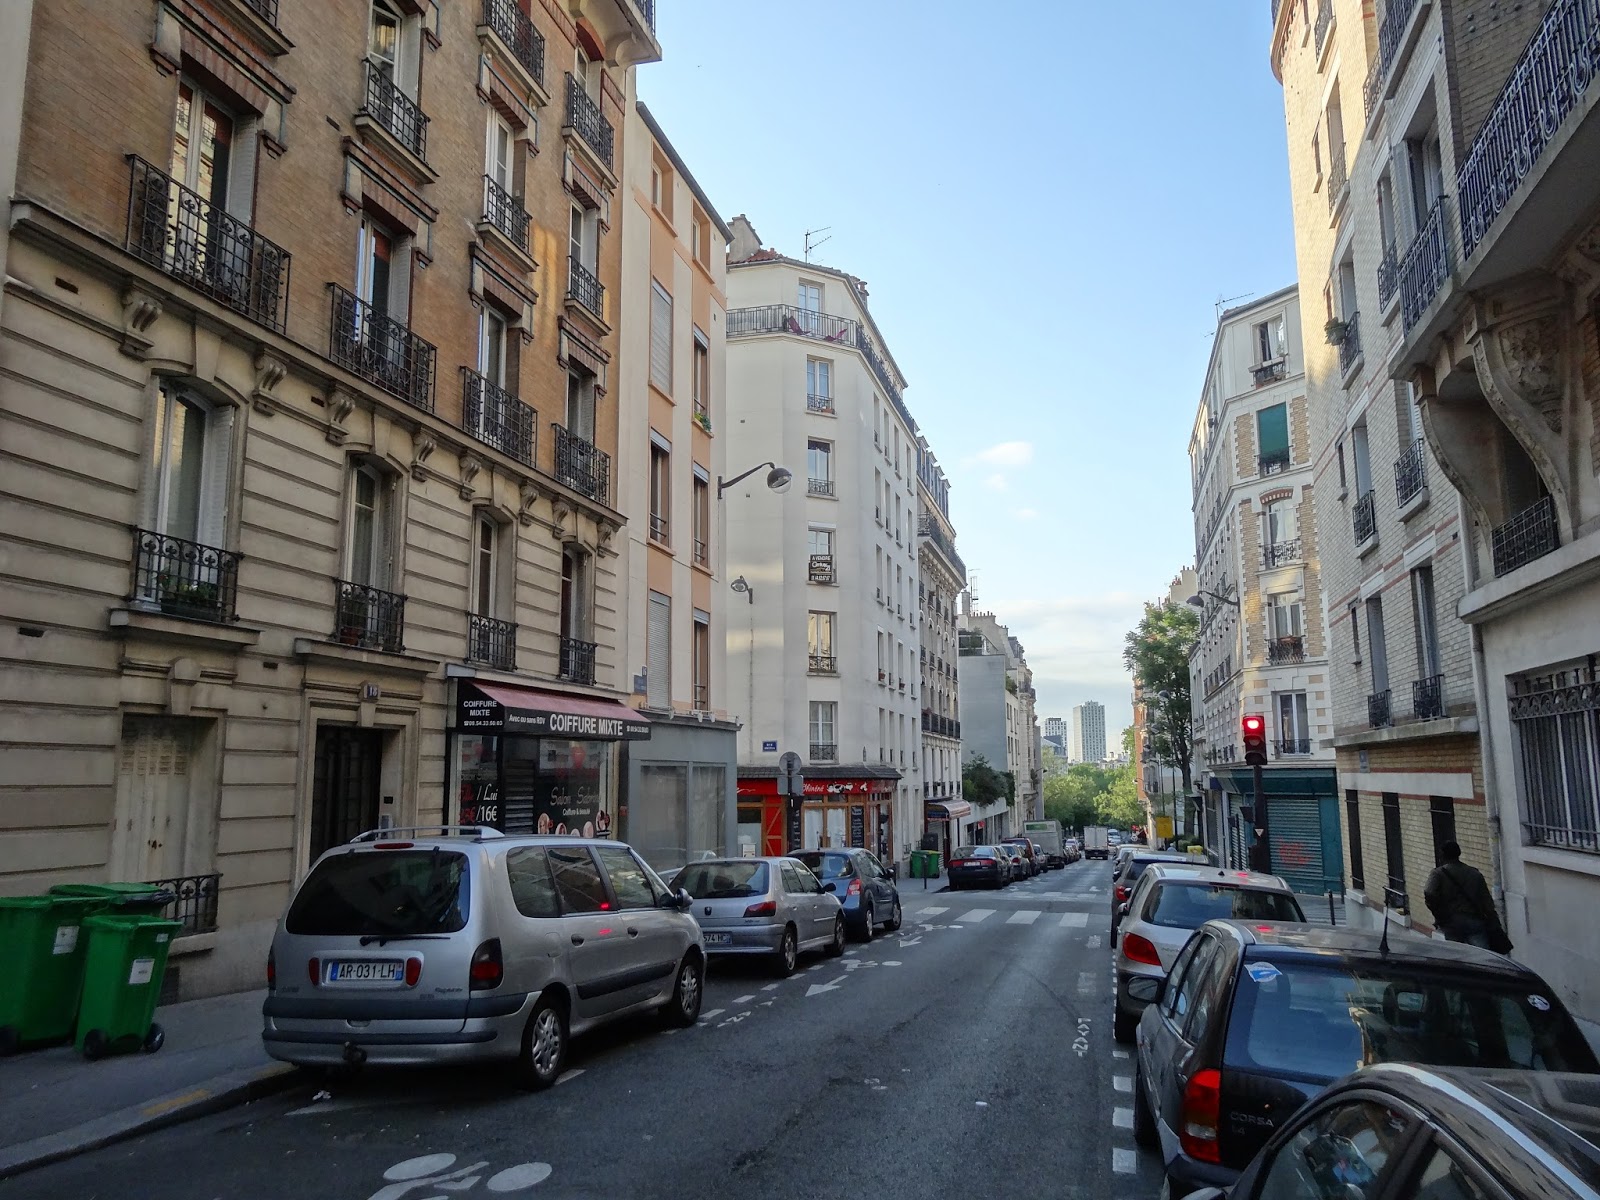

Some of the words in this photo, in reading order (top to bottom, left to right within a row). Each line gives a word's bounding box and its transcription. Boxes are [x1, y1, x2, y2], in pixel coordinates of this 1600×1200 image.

[463, 700, 498, 708] COIFFURE
[469, 709, 491, 717] MIXTE
[508, 714, 520, 722] Avec
[536, 716, 546, 725] RDV
[549, 713, 597, 734] COIFFURE
[598, 719, 624, 736] MIXTE
[483, 783, 499, 801] Lui
[550, 786, 572, 806] Salon
[339, 962, 395, 979] AR-031-LH
[1231, 1111, 1274, 1127] CORSA
